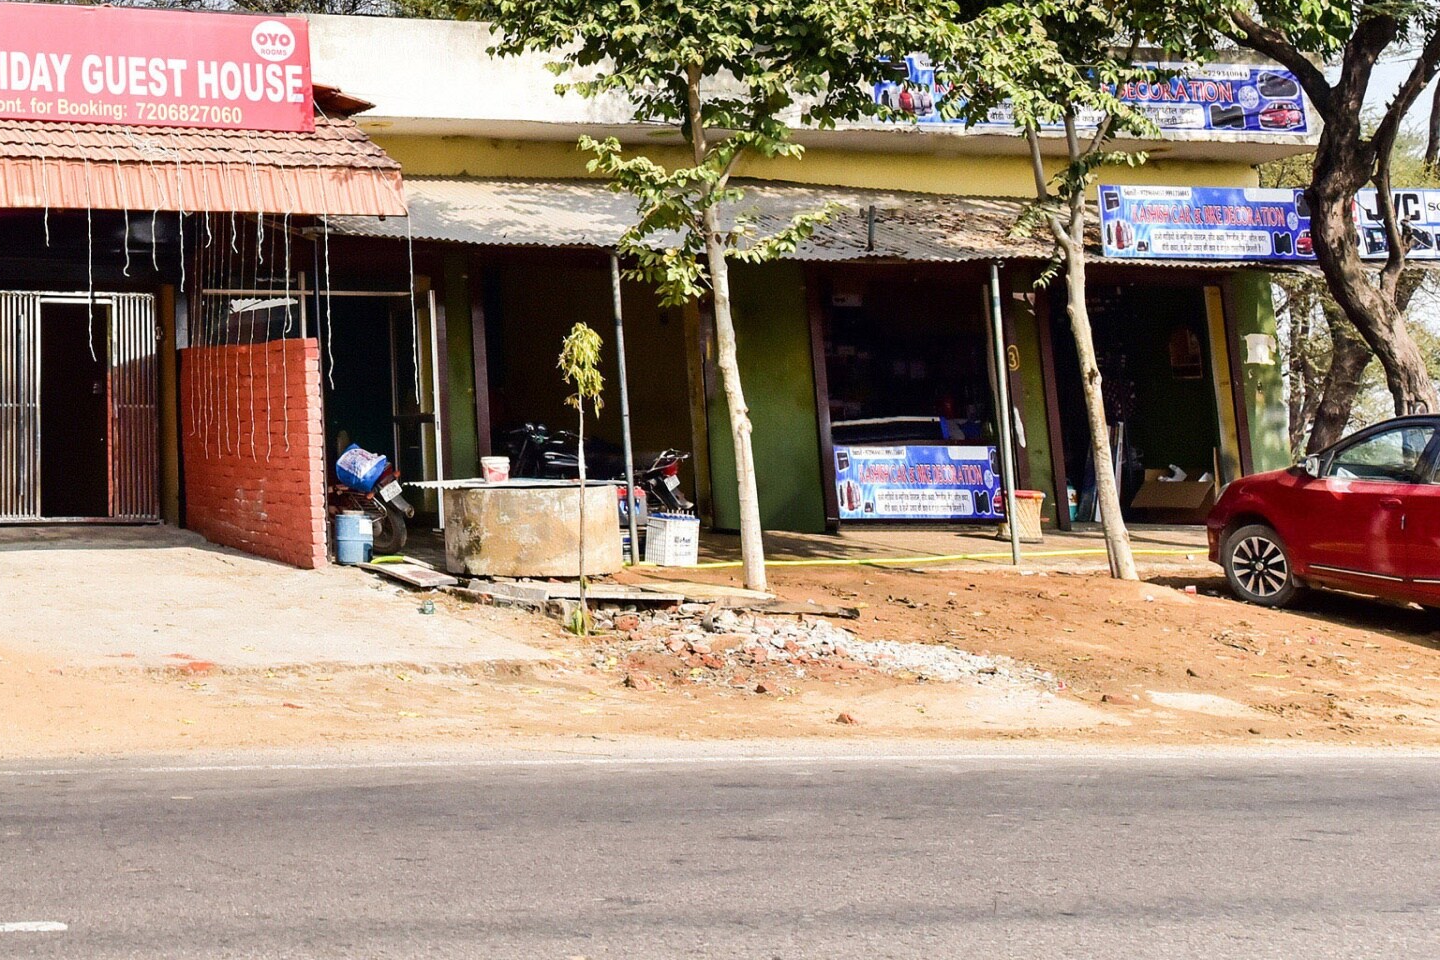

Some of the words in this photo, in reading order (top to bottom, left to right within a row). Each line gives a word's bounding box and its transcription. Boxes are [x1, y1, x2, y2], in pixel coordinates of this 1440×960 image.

[255, 32, 291, 47] OYO
[260, 48, 287, 56] ROOMS
[81, 54, 187, 98] GUEST
[197, 60, 305, 103] HOUSE
[30, 97, 53, 114] for
[57, 98, 127, 120] Booking:
[135, 102, 242, 124] 7206827060
[1171, 204, 1194, 225] CAR
[1223, 205, 1286, 227] DECORATION
[1008, 351, 1017, 368] 3
